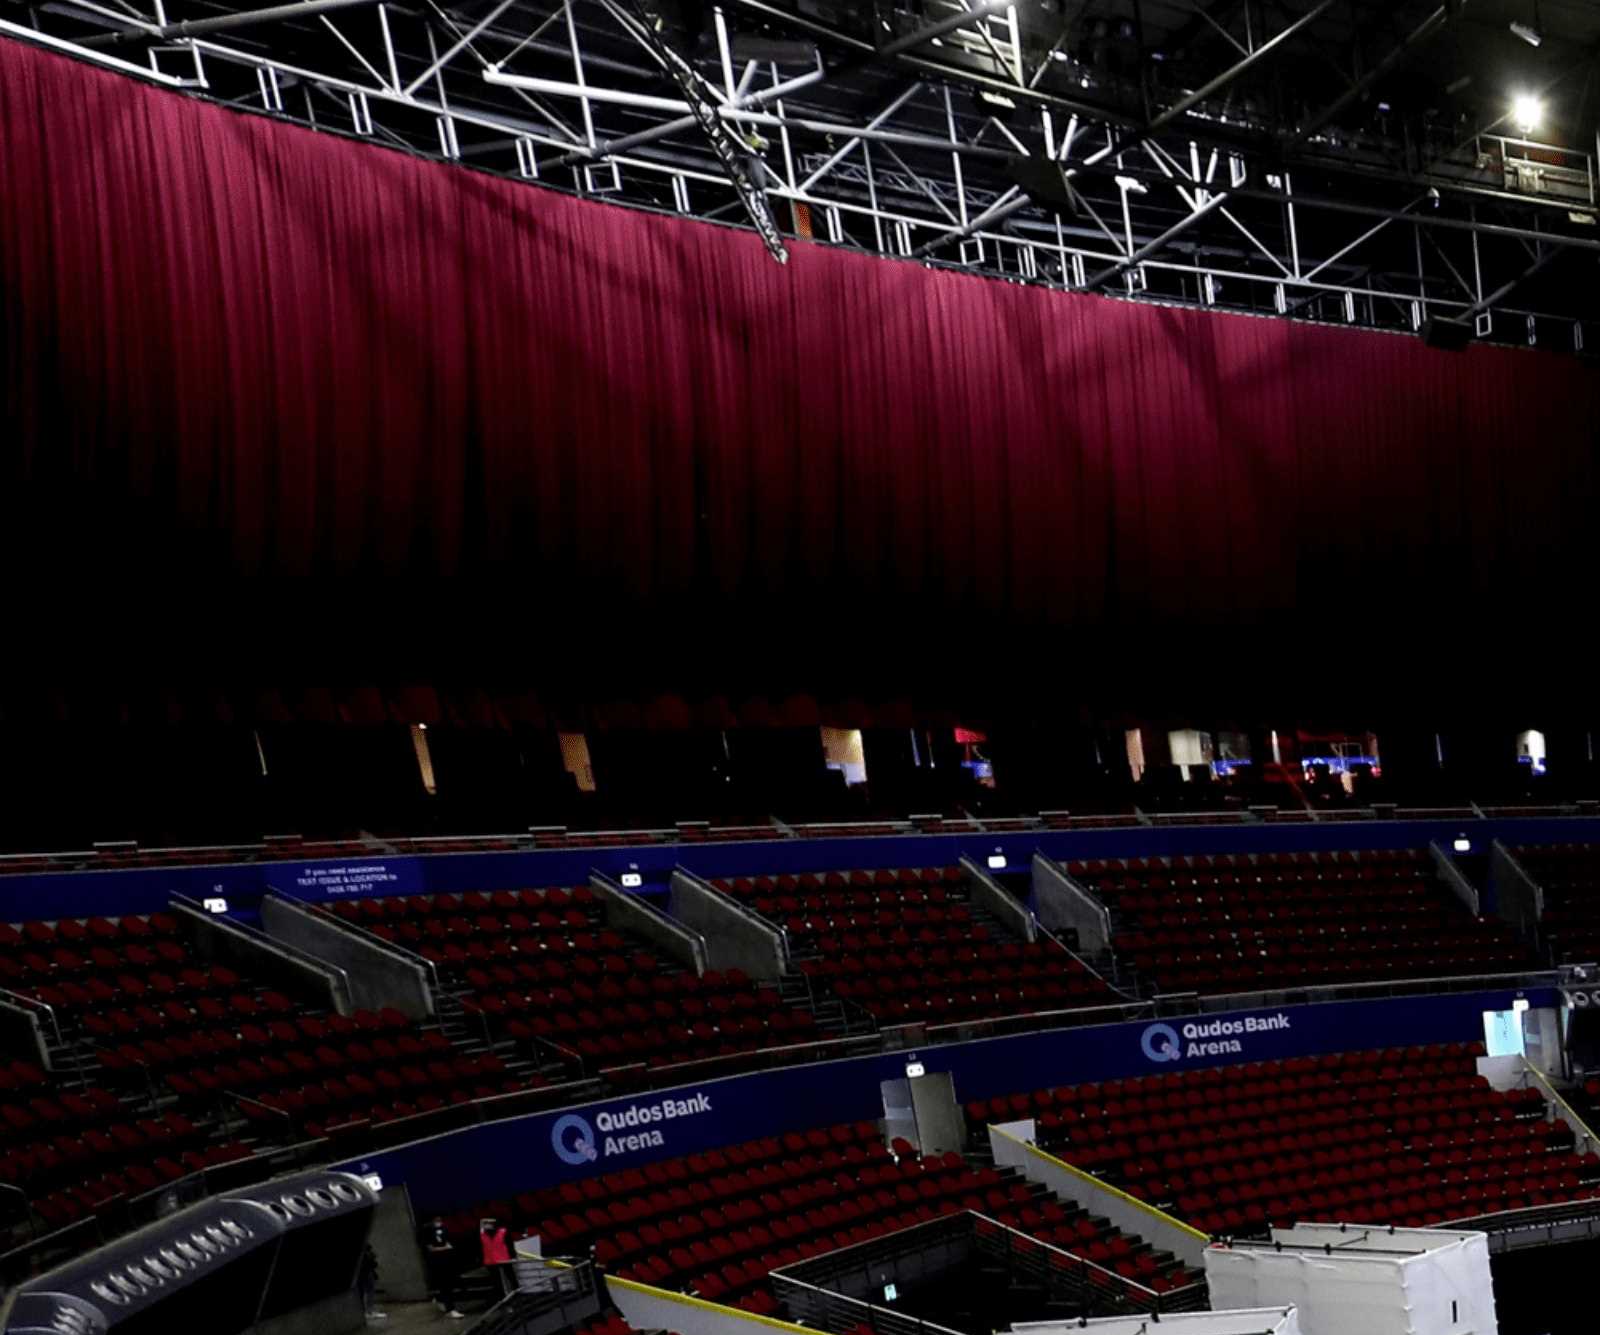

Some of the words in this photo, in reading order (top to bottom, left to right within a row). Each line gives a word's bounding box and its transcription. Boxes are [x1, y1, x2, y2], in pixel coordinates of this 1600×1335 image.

[1182, 1020, 1244, 1039] Qudos
[1244, 1012, 1291, 1032] Bank
[1185, 1038, 1242, 1058] Arena
[595, 1104, 664, 1132] Qudos
[661, 1091, 713, 1120] Bank
[603, 1129, 665, 1157] Arena
